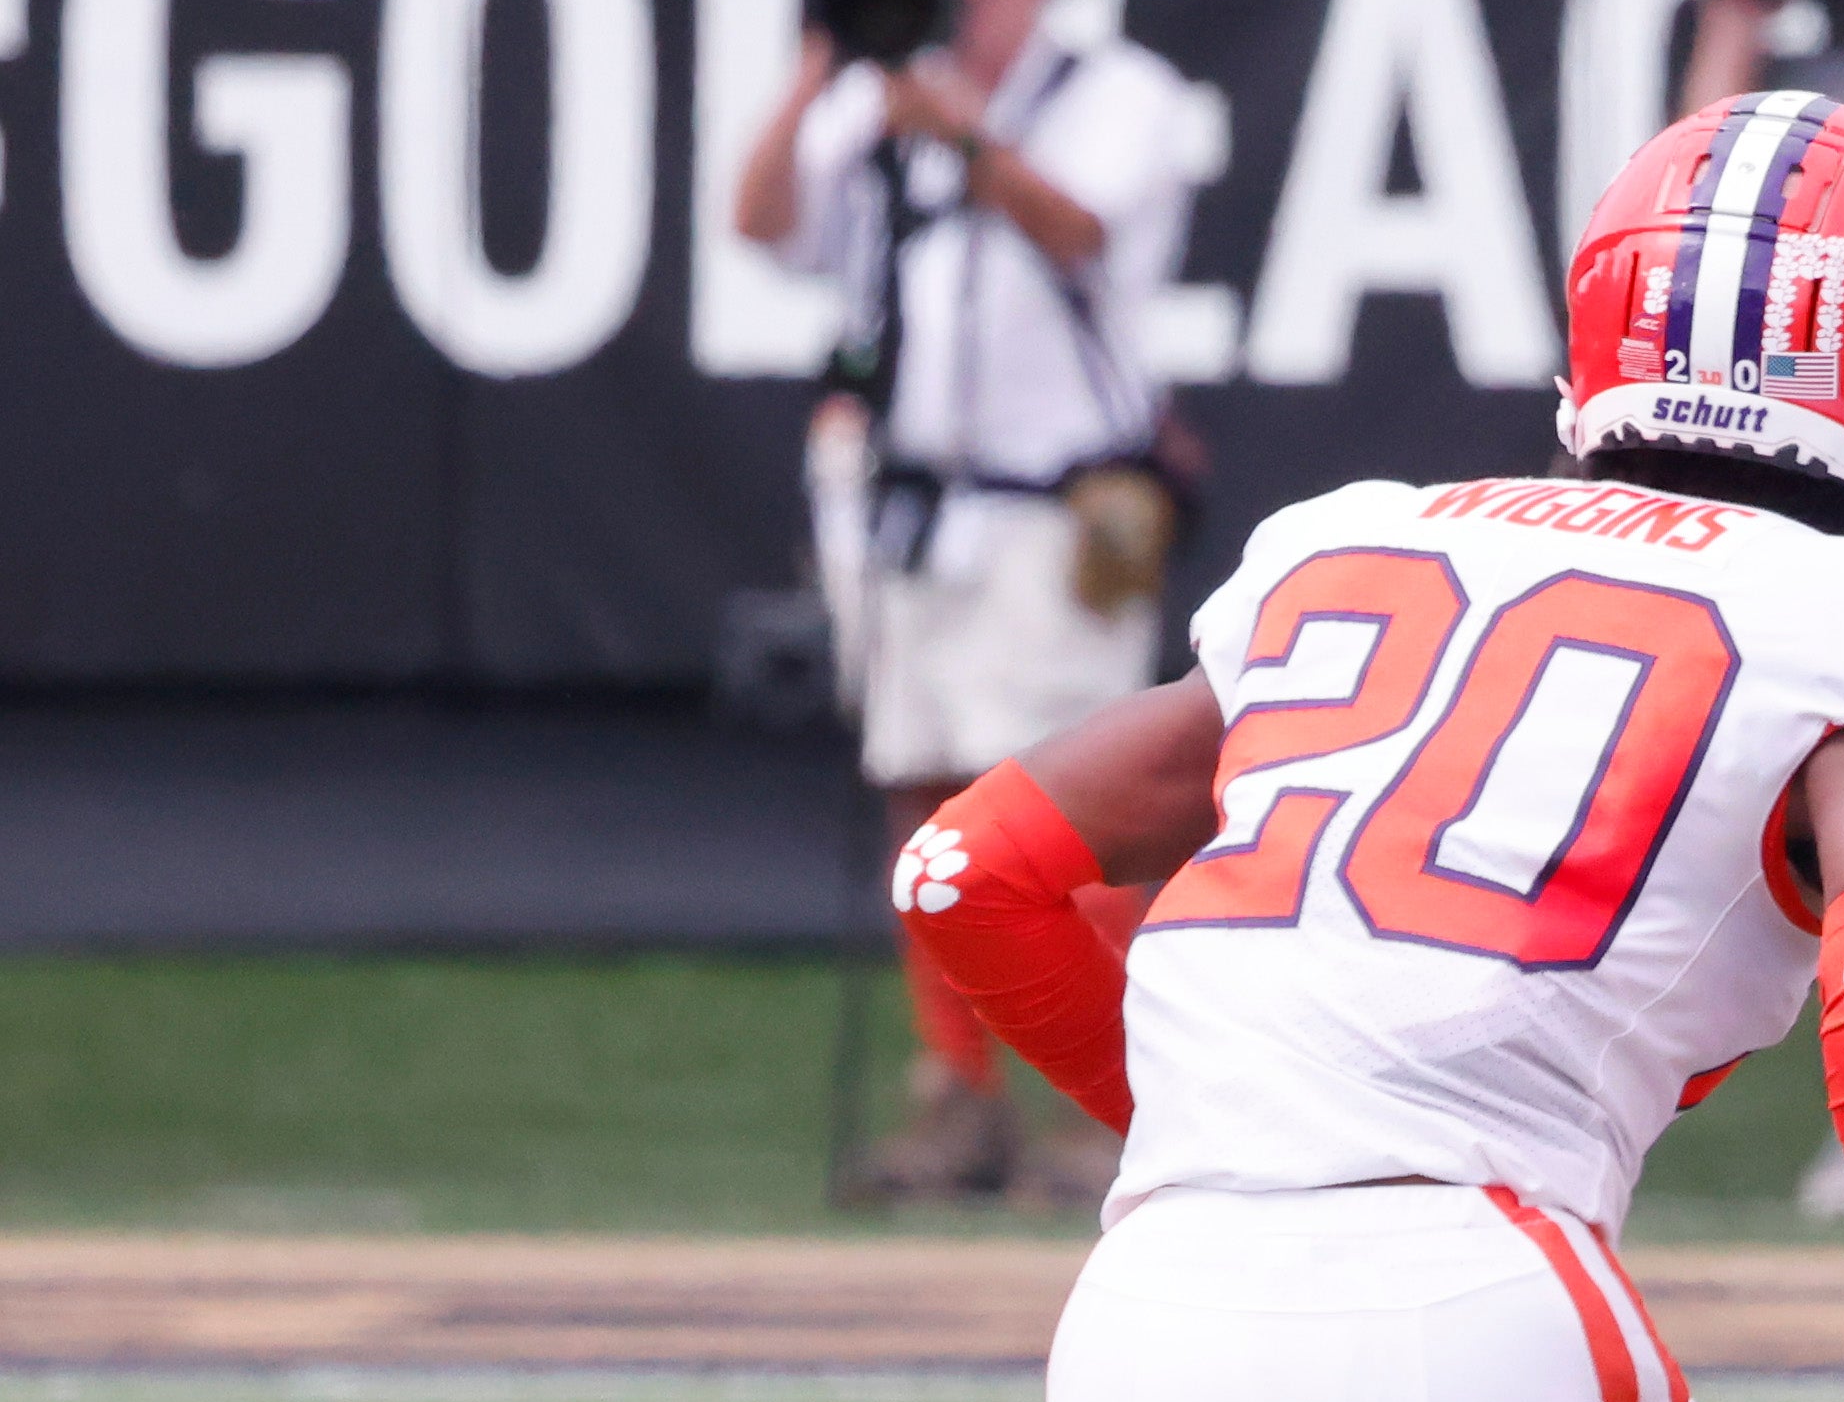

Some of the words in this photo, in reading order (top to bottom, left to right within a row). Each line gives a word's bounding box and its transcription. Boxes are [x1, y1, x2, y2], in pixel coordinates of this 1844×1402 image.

[1653, 395, 1769, 433] schutt
[1419, 478, 1758, 553] WIGGINS
[1137, 546, 1741, 971] 20
